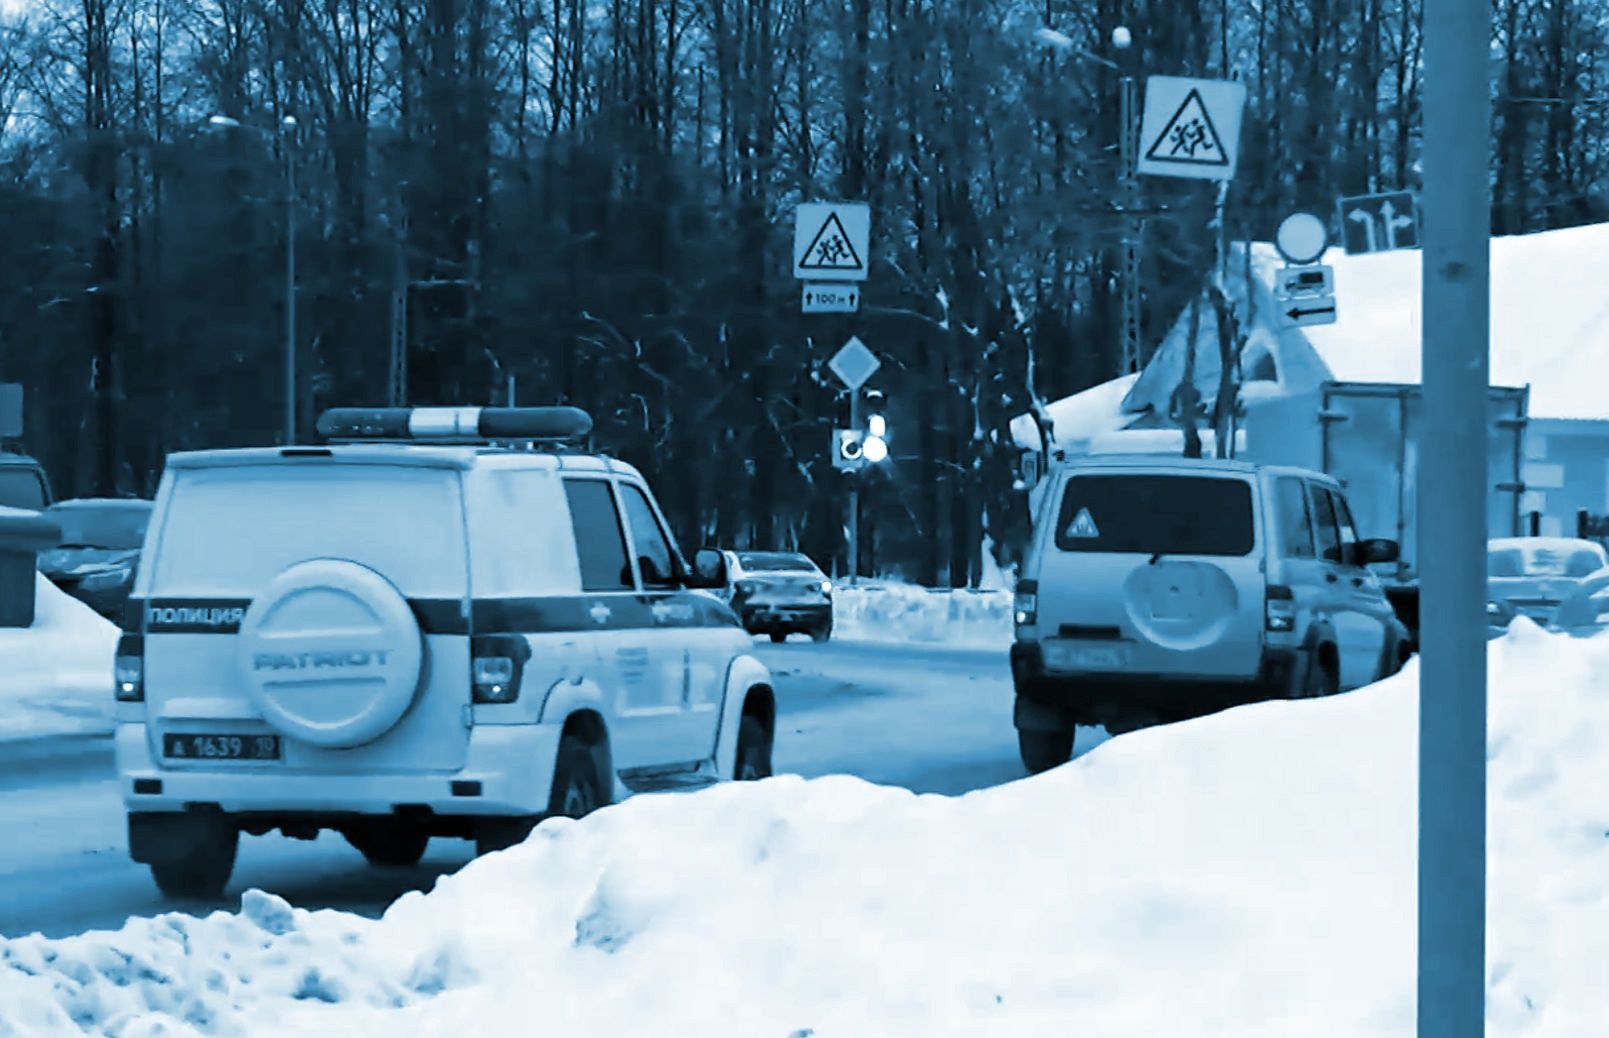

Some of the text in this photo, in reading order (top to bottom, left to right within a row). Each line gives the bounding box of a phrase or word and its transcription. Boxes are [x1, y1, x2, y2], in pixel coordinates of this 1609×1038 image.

[148, 608, 244, 625] ПОЛИЦИЯ
[253, 650, 389, 670] PATRIOT
[193, 736, 242, 757] 1639
